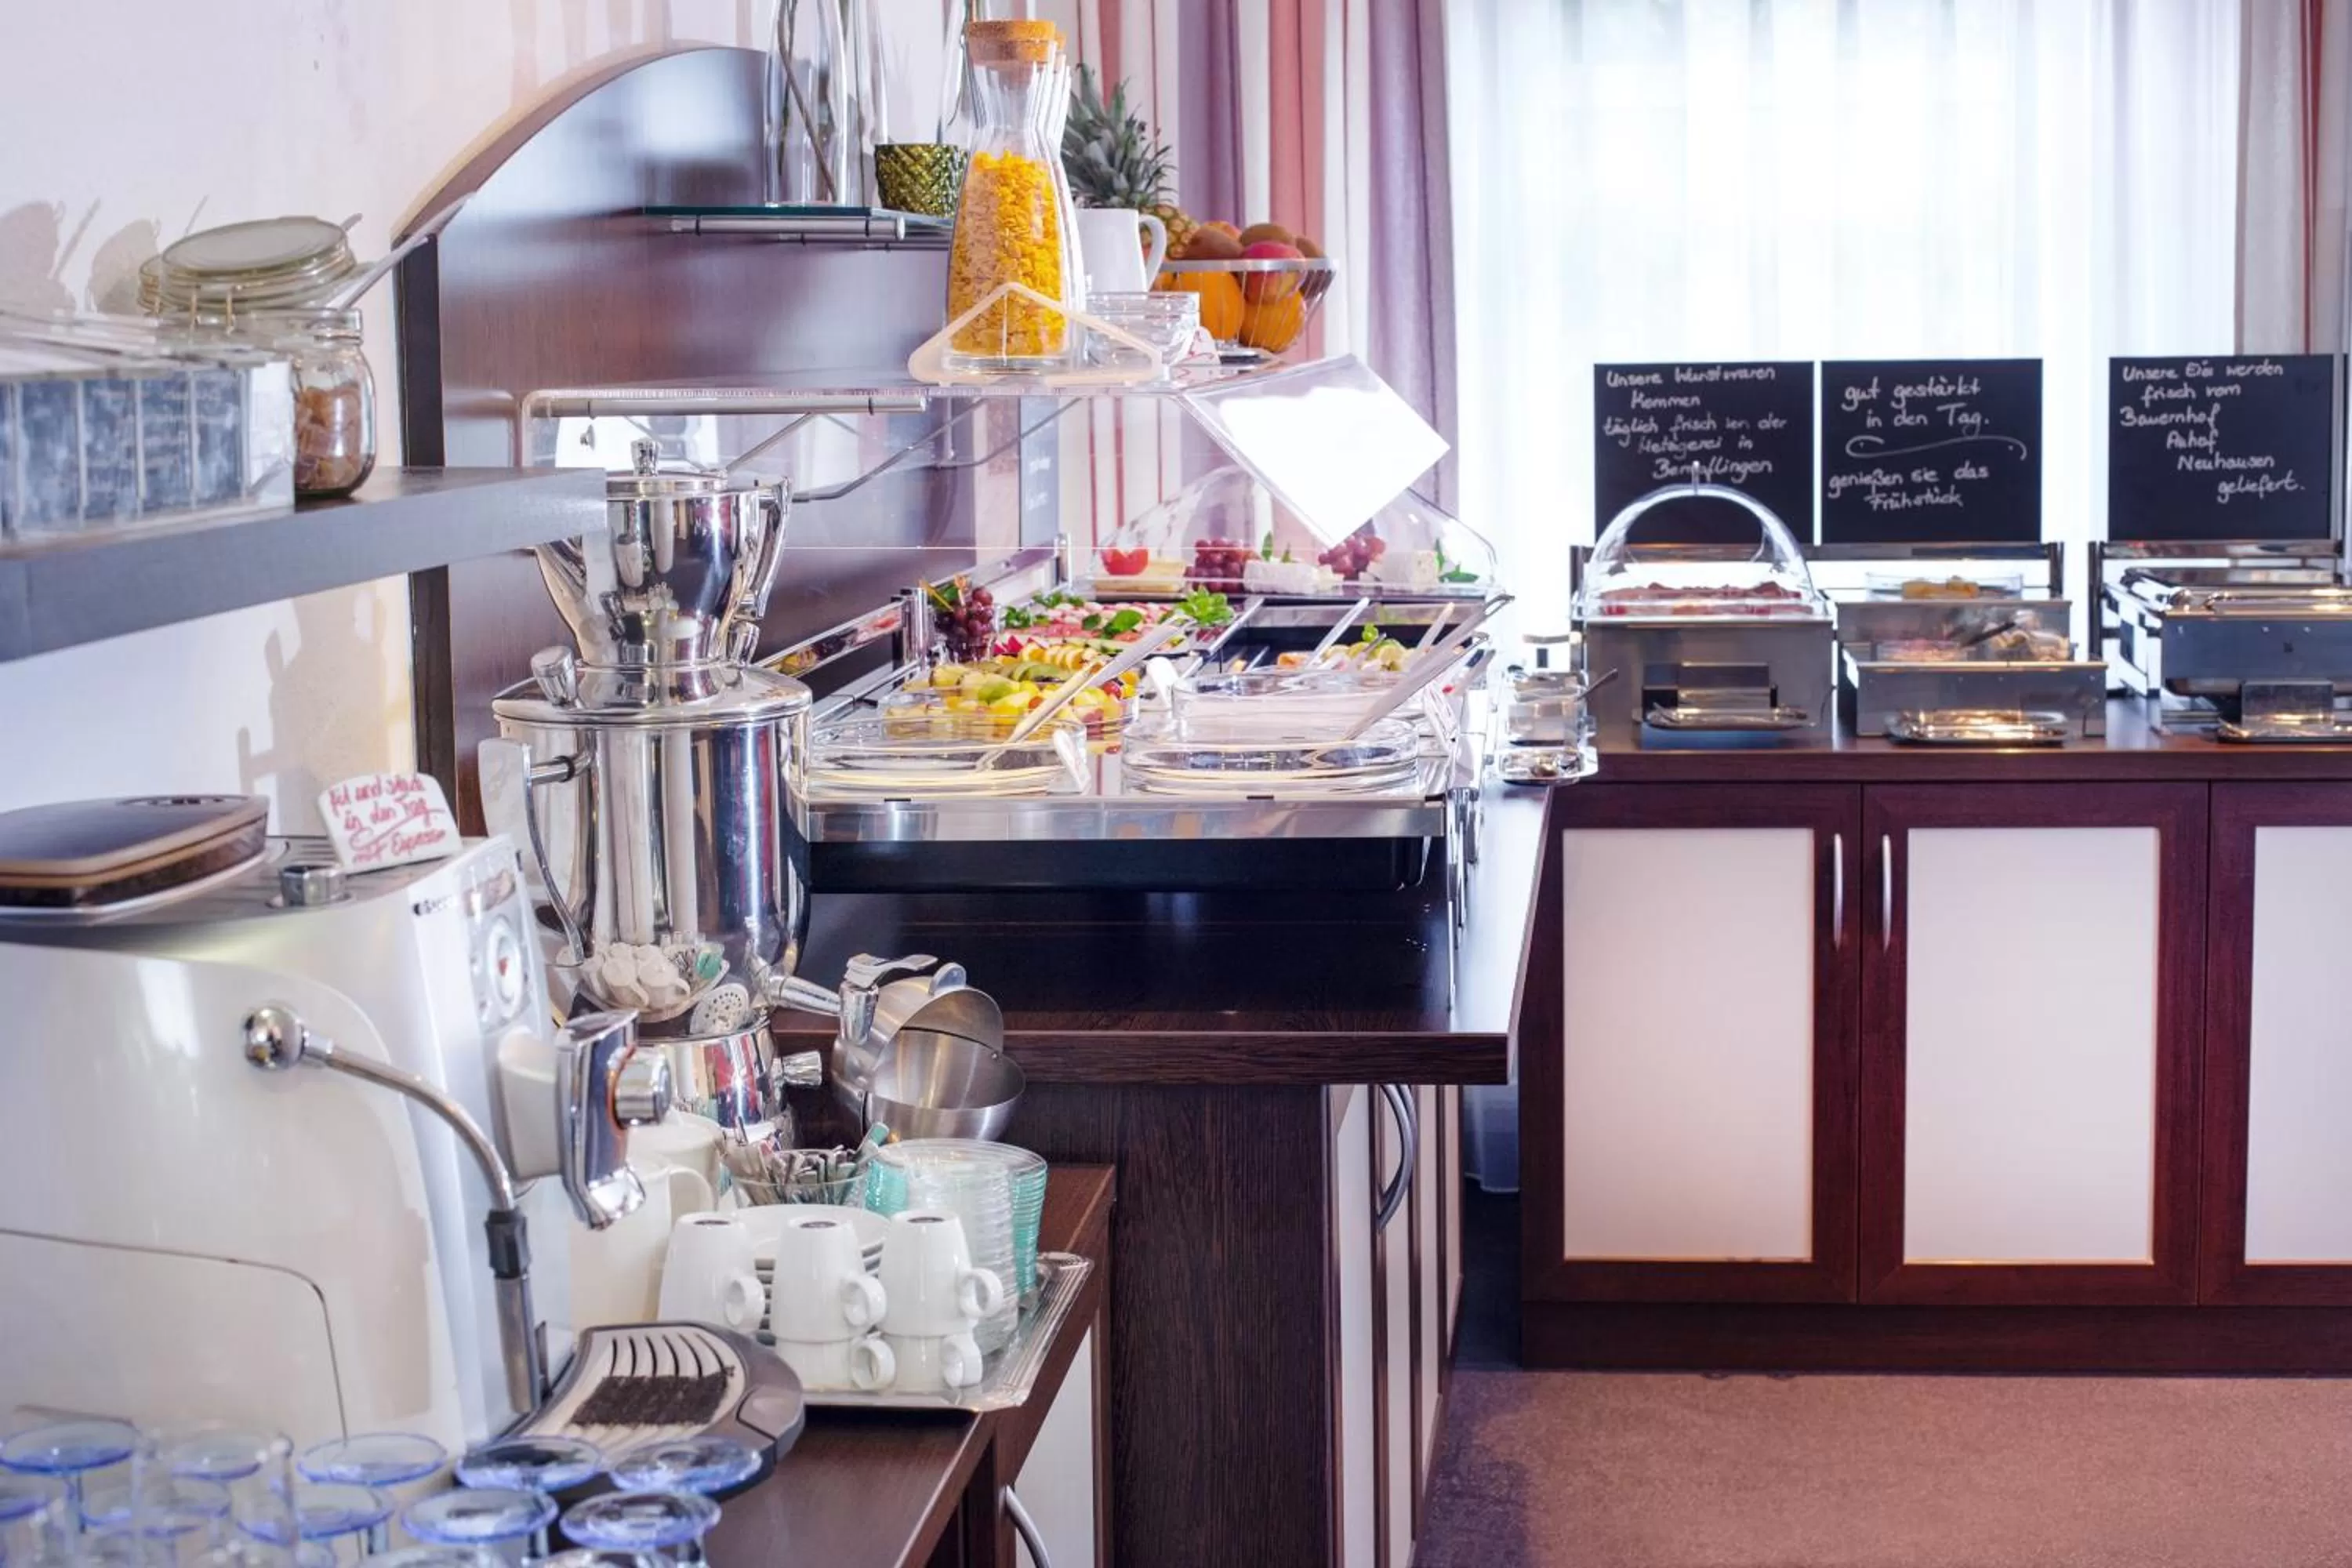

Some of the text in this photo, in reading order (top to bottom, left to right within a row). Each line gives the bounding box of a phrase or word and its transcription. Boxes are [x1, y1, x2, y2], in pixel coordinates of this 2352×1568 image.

[1606, 370, 1663, 387] Unsere
[2122, 365, 2178, 382] Unsere
[2226, 358, 2284, 377] werden
[1841, 375, 1981, 412] gut gestärkt
[2140, 382, 2241, 408] frisch vom
[1866, 402, 1990, 437] in den Tag.
[2119, 402, 2222, 430] Bauernhof
[1602, 416, 1659, 448] täglich
[1668, 412, 1718, 440] frisch
[1757, 412, 1788, 430] der
[1737, 434, 1754, 450] in
[1954, 460, 1990, 480] das
[2177, 452, 2275, 471] Neuhausen
